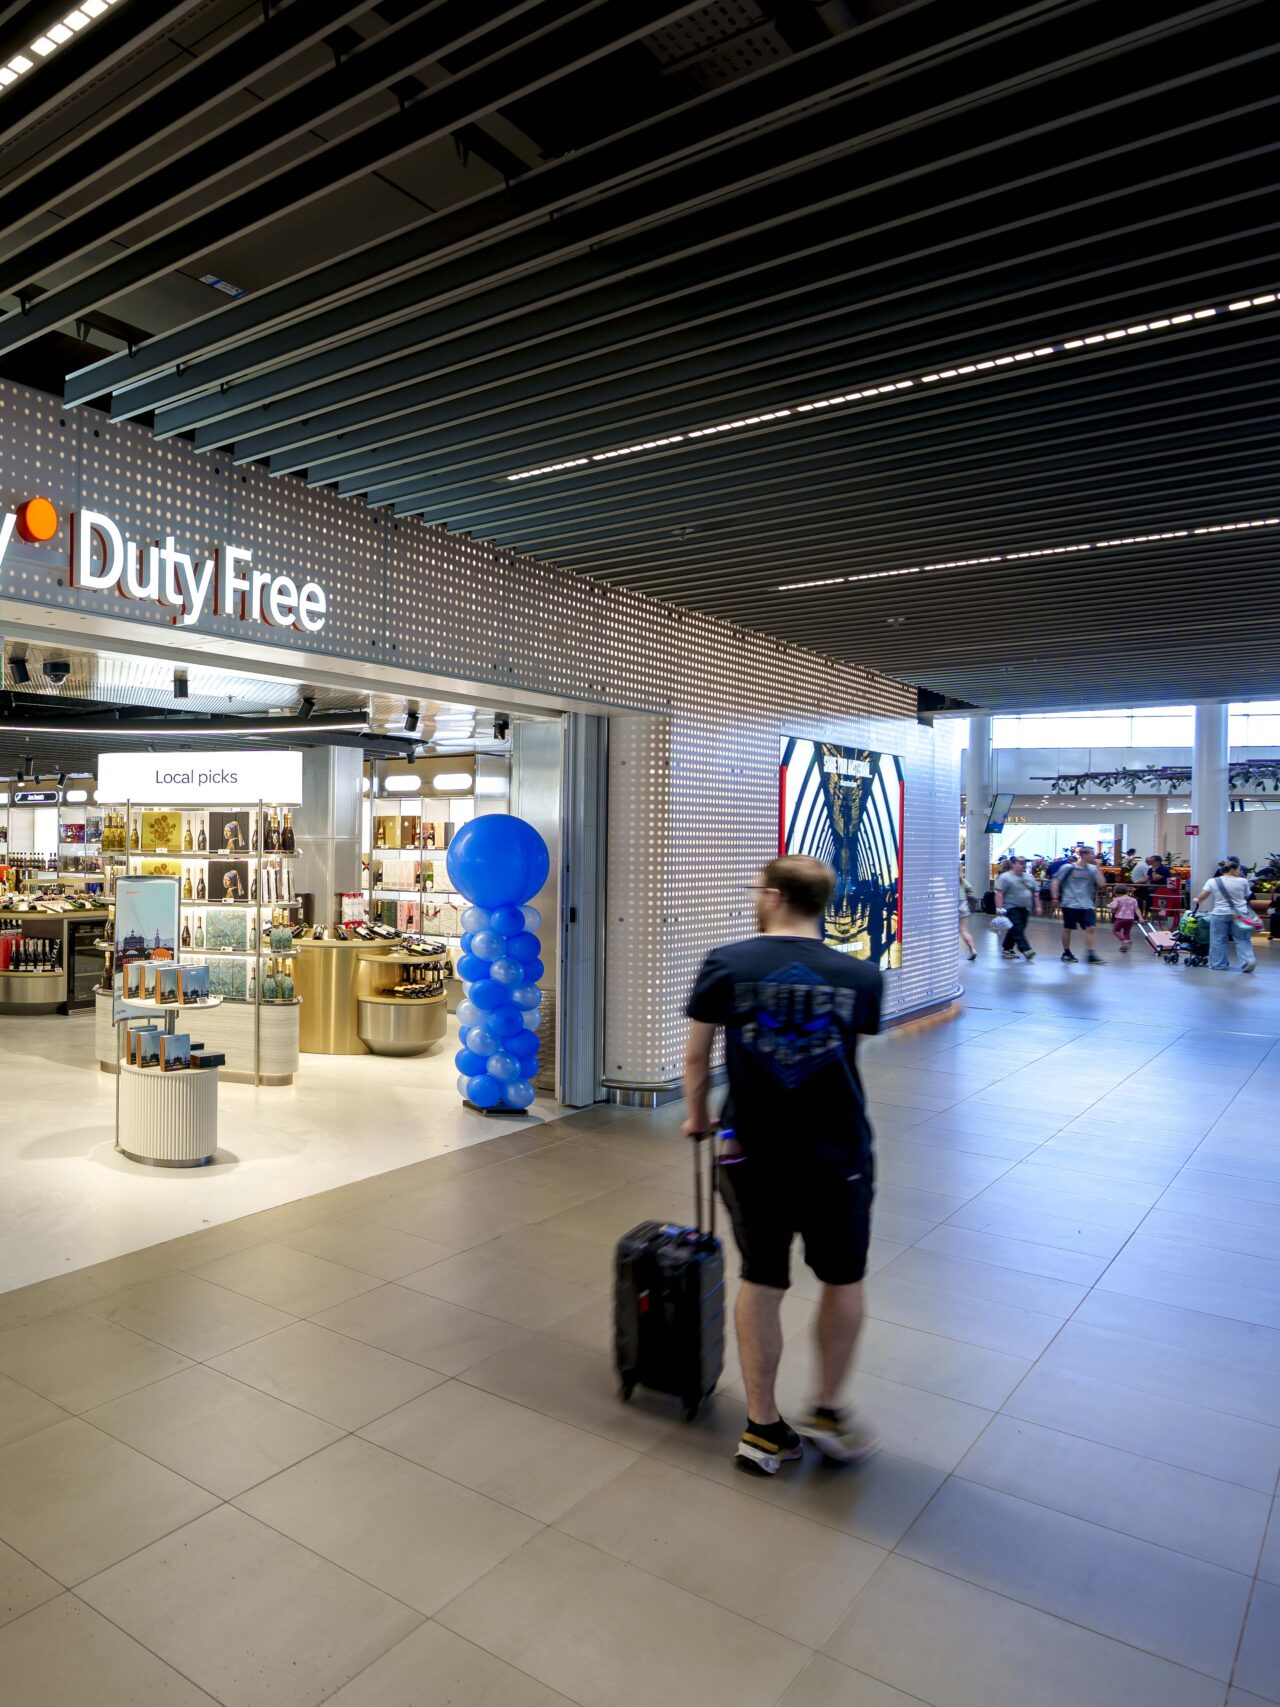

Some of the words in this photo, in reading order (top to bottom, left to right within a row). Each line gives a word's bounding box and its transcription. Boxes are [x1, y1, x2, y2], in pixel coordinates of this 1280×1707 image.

[70, 508, 213, 625] Duty
[220, 545, 328, 633] Free
[155, 769, 194, 784] Local
[198, 768, 239, 787] picks
